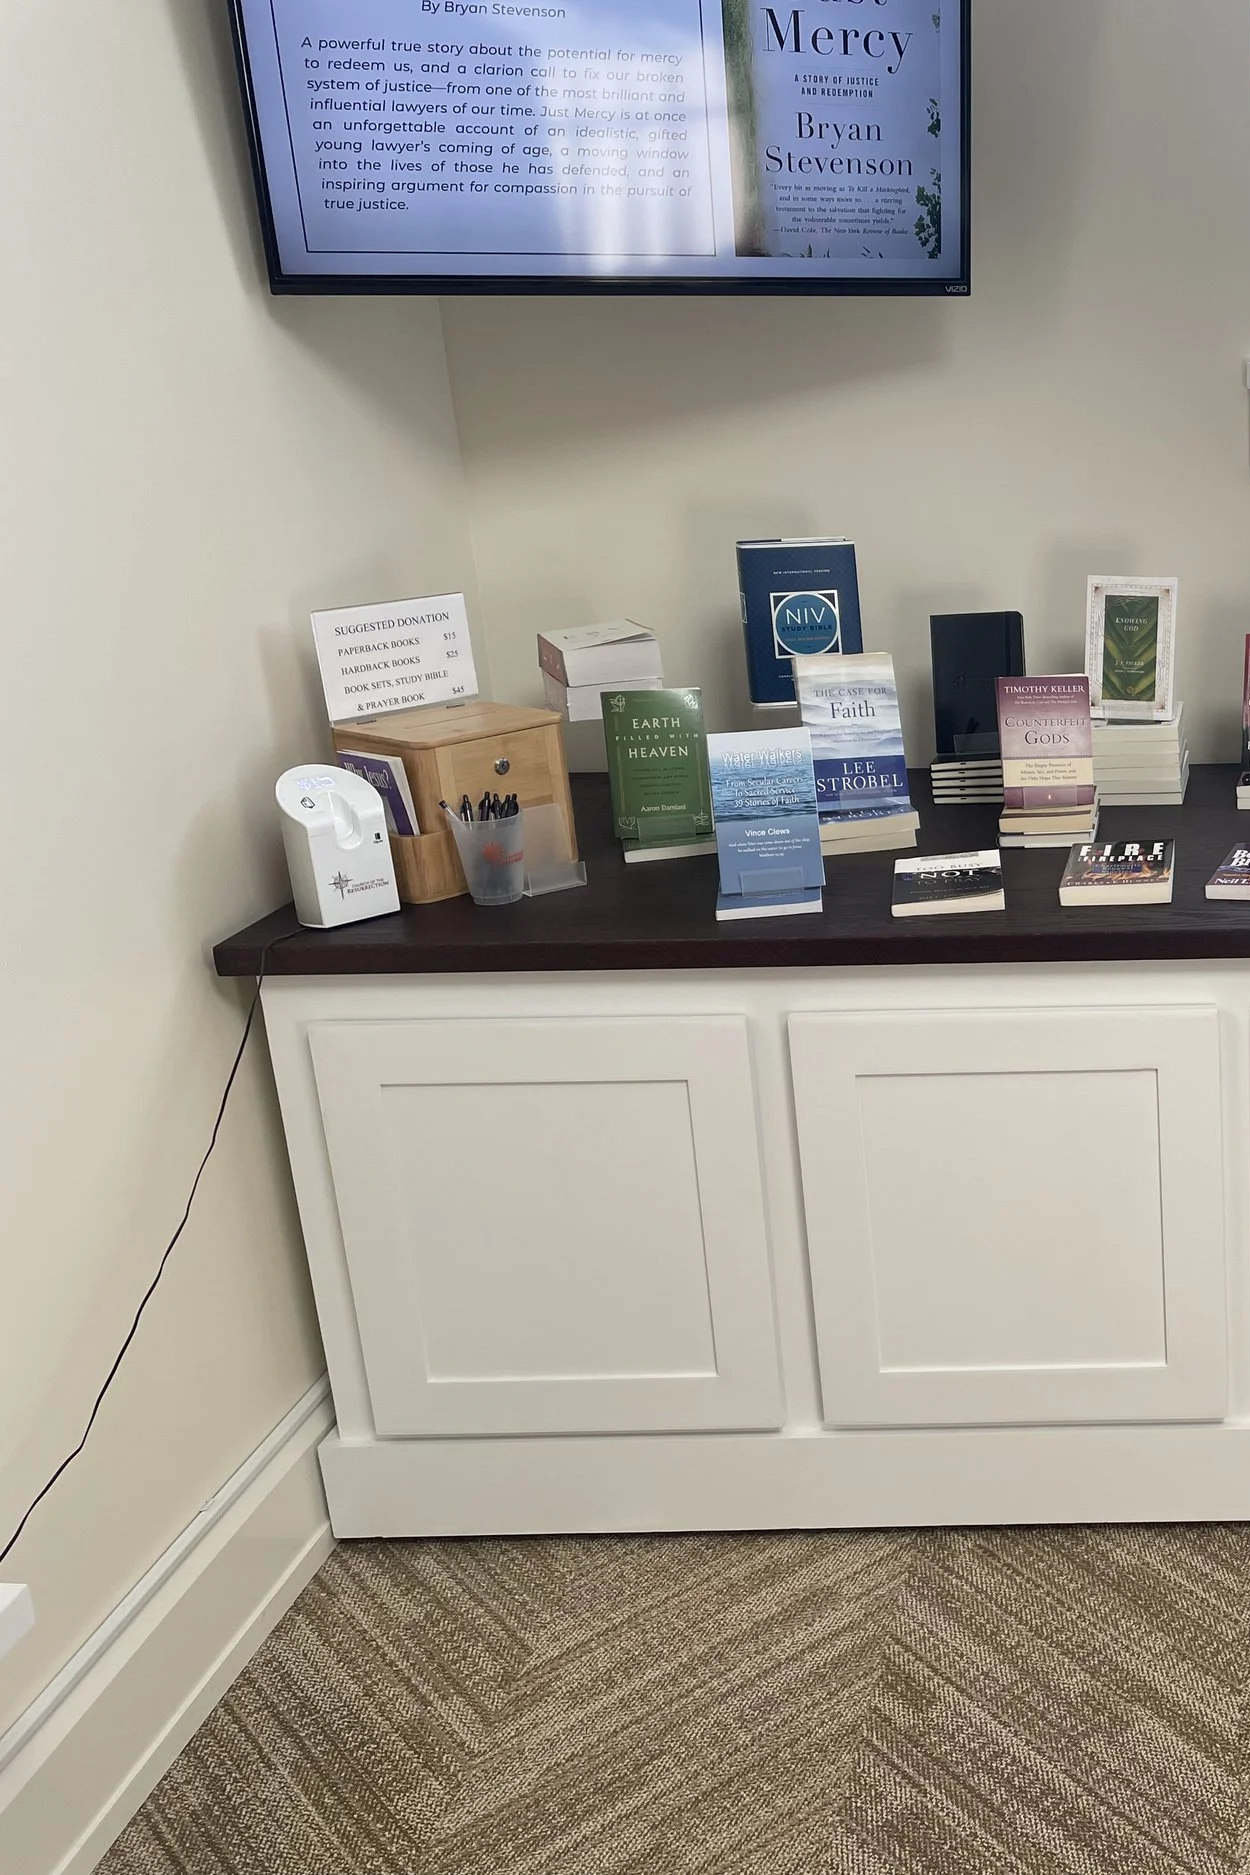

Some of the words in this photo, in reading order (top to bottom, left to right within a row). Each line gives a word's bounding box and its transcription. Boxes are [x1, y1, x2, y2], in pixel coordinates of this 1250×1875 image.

[421, 0, 440, 14] By
[444, 0, 488, 16] Bryan
[492, 3, 566, 18] Stevenson
[760, 8, 914, 74] Mercy
[301, 36, 312, 48] A
[318, 38, 385, 51] powerful
[391, 40, 422, 52] true
[427, 42, 464, 56] story
[468, 43, 512, 56] about
[518, 45, 542, 57] the
[547, 48, 611, 61] potential
[616, 50, 635, 62] for
[640, 54, 682, 66] mercy
[304, 58, 320, 69] to
[328, 58, 385, 71] redeem
[394, 62, 413, 74] us,
[420, 62, 450, 73] and
[458, 64, 466, 74] a
[474, 63, 523, 76] clarion
[530, 66, 556, 78] call
[563, 68, 577, 79] to
[606, 70, 630, 81] our
[636, 69, 684, 83] broken
[794, 74, 800, 82] A
[803, 74, 829, 84] STORY
[833, 76, 842, 85] OF
[846, 76, 879, 86] JUSTICE
[307, 79, 360, 92] system
[365, 79, 380, 91] of
[382, 79, 481, 94] justice—from
[485, 86, 512, 96] one
[516, 84, 531, 96] of
[535, 86, 558, 98] the
[562, 88, 598, 100] most
[602, 88, 654, 101] brilliant
[658, 91, 685, 103] and
[801, 87, 817, 96] AND
[821, 88, 874, 98] REDEMPTION
[309, 98, 386, 112] influential
[392, 100, 448, 116] lawyers
[452, 102, 468, 114] of
[471, 105, 494, 116] our
[500, 104, 536, 117] time.
[539, 106, 569, 118] Just
[574, 107, 616, 122] Mercy
[620, 108, 630, 120] is
[635, 109, 649, 121] at
[654, 112, 687, 122] once
[312, 120, 332, 130] an
[343, 120, 446, 134] unforgettable
[455, 124, 514, 136] account
[524, 124, 540, 136] of
[548, 127, 566, 137] an
[795, 111, 883, 150] Bryan
[315, 140, 363, 153] young
[371, 139, 431, 154] lawyer's
[438, 142, 493, 156] coming
[501, 143, 516, 154] of
[522, 145, 552, 158] age,
[318, 158, 348, 170] into
[356, 158, 382, 171] the
[390, 159, 422, 171] lives
[431, 160, 447, 172] of
[454, 161, 494, 173] those
[502, 162, 520, 174] he
[528, 163, 554, 175] has
[765, 145, 912, 176] Stevenson
[321, 178, 386, 193] inspiring
[391, 180, 464, 193] argument
[470, 180, 489, 192] for
[494, 182, 578, 196] compassion
[324, 198, 354, 210] true
[356, 198, 409, 212] justice.
[334, 619, 395, 636] SUGGESTED
[397, 612, 450, 627] DONATION
[786, 606, 826, 625] NIV
[338, 642, 390, 657] PAPERBACK
[391, 637, 420, 649] BOOKS
[443, 632, 457, 641] $15
[340, 661, 390, 676] HARDBACK
[391, 656, 421, 668] BOOKS
[446, 650, 459, 659] $25
[344, 684, 370, 695] BOOK
[371, 680, 394, 690] SETS,
[395, 674, 423, 686] STUDY
[425, 670, 449, 681] BIBLE
[1004, 685, 1048, 694] TIMOTHY
[1051, 685, 1085, 693] KELLER
[357, 703, 365, 712] &
[366, 698, 400, 712] PRAYER
[401, 693, 425, 704] BOOK
[452, 686, 465, 695] $45
[814, 690, 835, 698] THE
[838, 688, 864, 697] CASE
[868, 687, 888, 695] FOR
[830, 700, 876, 719] Faith
[632, 717, 681, 729] EARTH
[1005, 716, 1086, 728] COUNTERFEIT
[615, 734, 660, 742] FILLED
[1024, 730, 1070, 745] GODS
[628, 746, 689, 759] HEAVEN
[722, 752, 755, 762] Water
[758, 748, 802, 762] Walkers
[843, 761, 876, 775] LEE
[363, 766, 392, 790] Jesus?
[816, 773, 904, 792] STROBEL
[640, 804, 660, 813] Aaron
[734, 799, 744, 808] 39
[745, 798, 770, 807] Stories
[781, 795, 800, 805] Faith
[1080, 842, 1164, 857] FIRE
[920, 868, 979, 879] NOT
